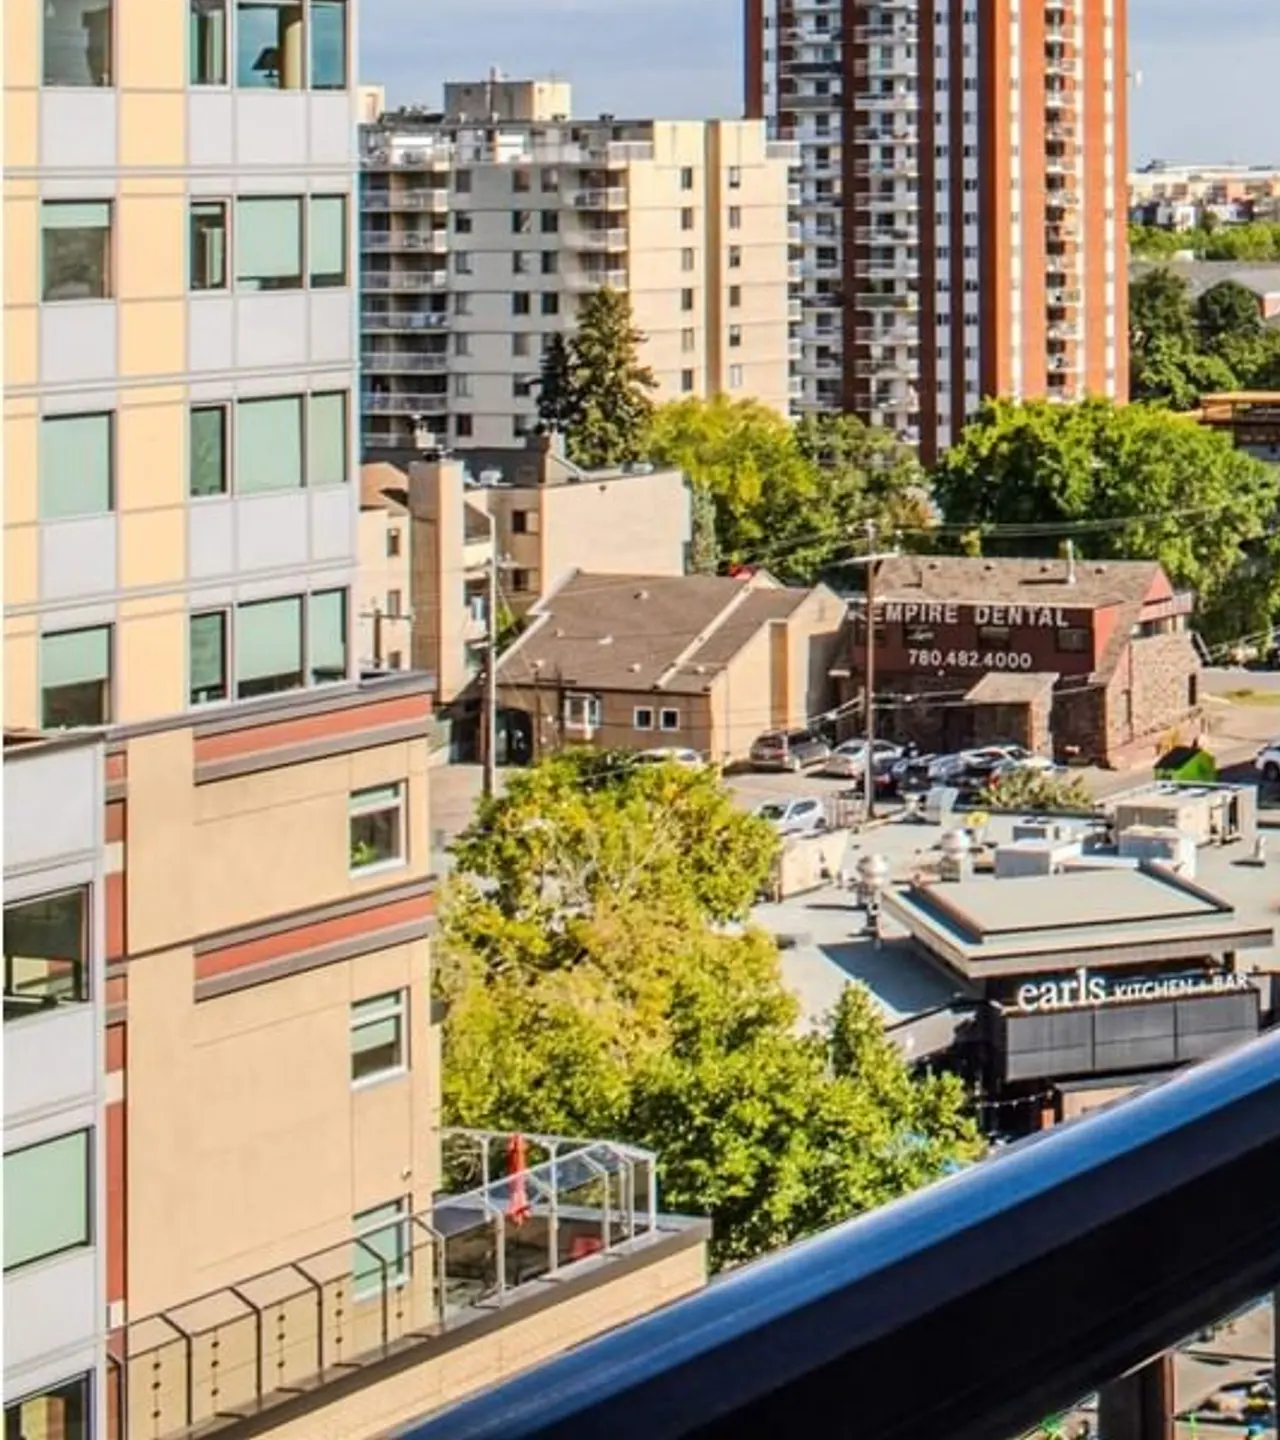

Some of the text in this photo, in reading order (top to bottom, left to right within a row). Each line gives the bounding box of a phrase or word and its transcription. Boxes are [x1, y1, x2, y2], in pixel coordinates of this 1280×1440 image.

[974, 606, 1069, 627] DENTAL
[908, 648, 1032, 669] 780.482.4000
[1017, 967, 1106, 1011] earls
[1113, 977, 1193, 998] KITCHEN
[1213, 973, 1249, 991] BAR
